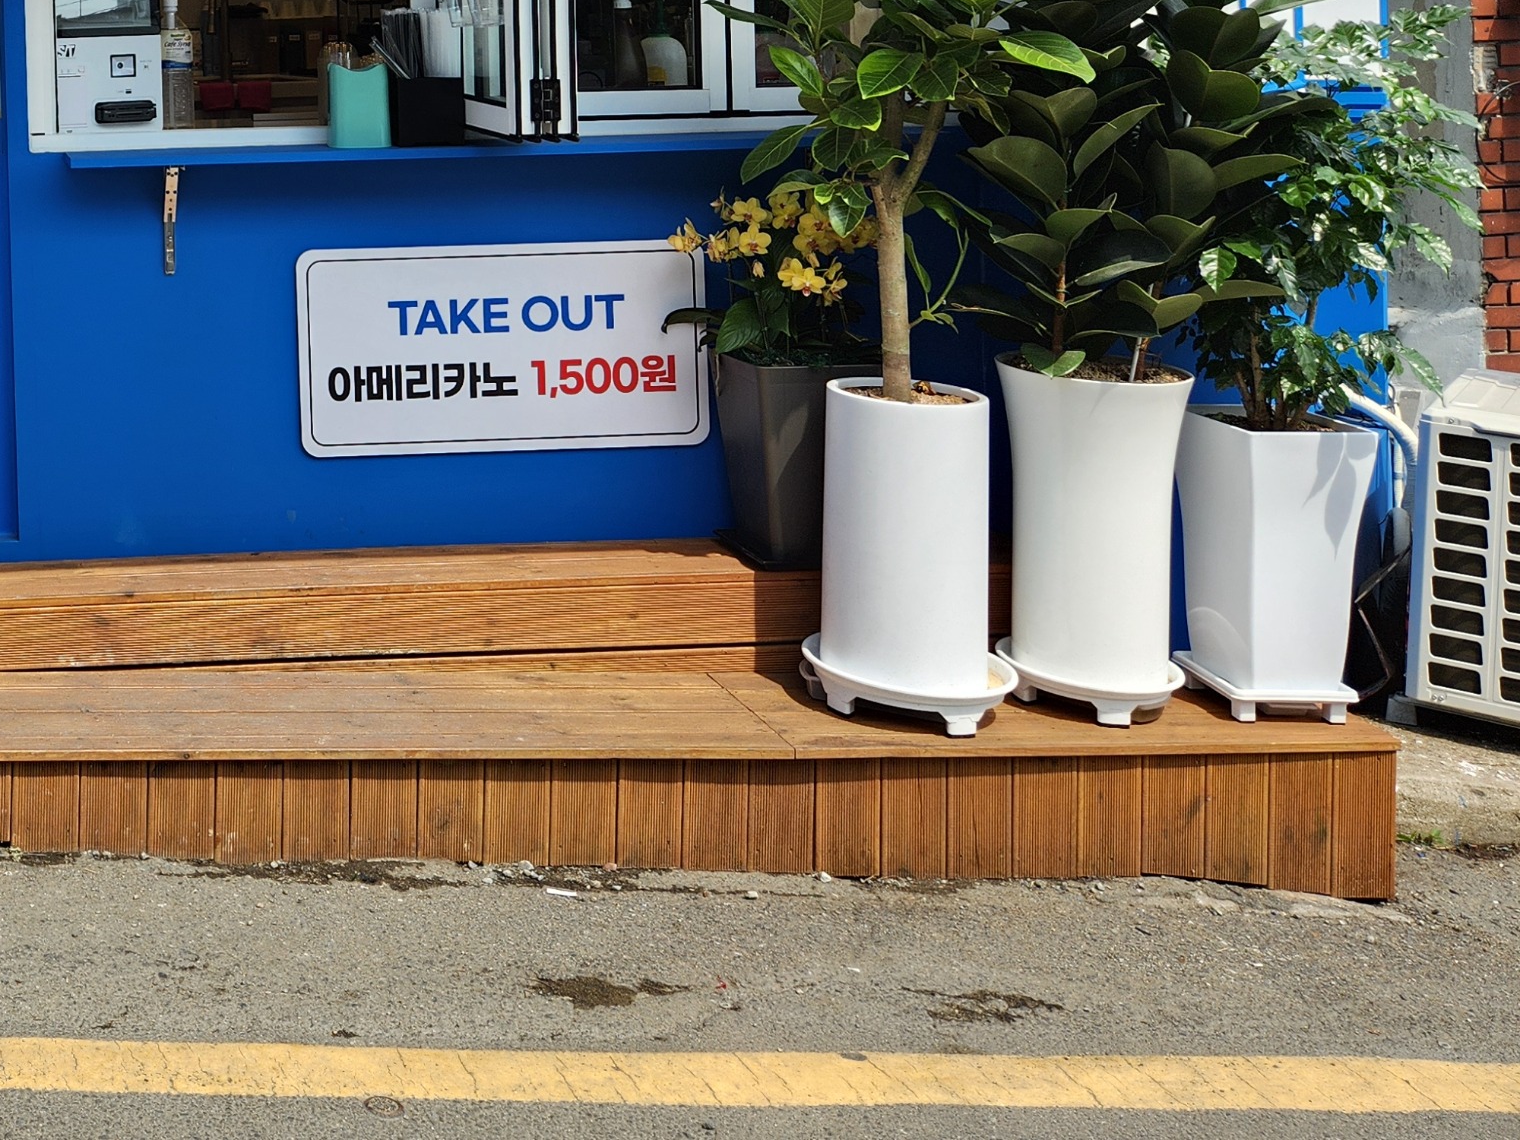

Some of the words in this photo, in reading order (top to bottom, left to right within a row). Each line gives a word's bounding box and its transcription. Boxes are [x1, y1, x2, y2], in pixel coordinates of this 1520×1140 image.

[388, 297, 510, 336] TAKE
[521, 293, 625, 332] OUT
[328, 361, 519, 403] 아메리카노
[530, 353, 678, 399] 1,500원
